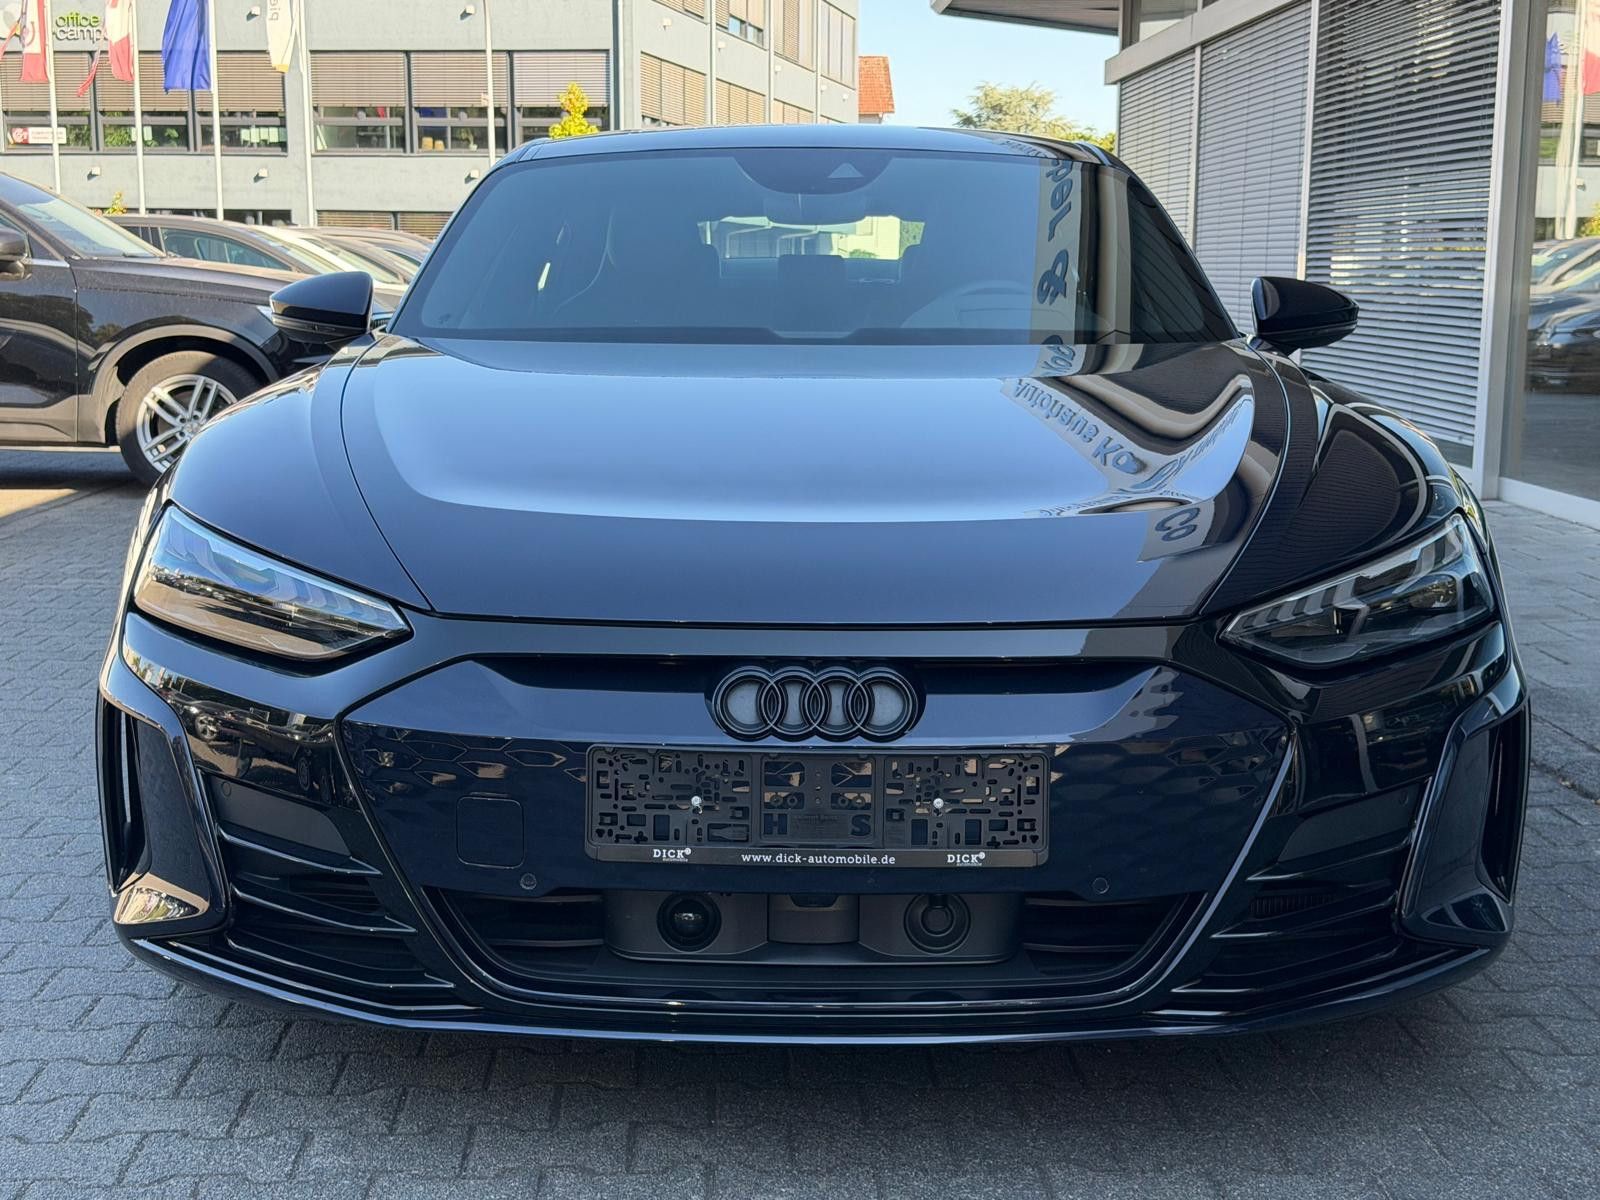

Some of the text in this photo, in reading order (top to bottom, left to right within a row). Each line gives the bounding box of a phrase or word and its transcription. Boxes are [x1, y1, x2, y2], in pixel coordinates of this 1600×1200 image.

[653, 848, 686, 859] DICK
[741, 853, 896, 865] www.dick-automobile.de
[947, 853, 979, 863] DICK
